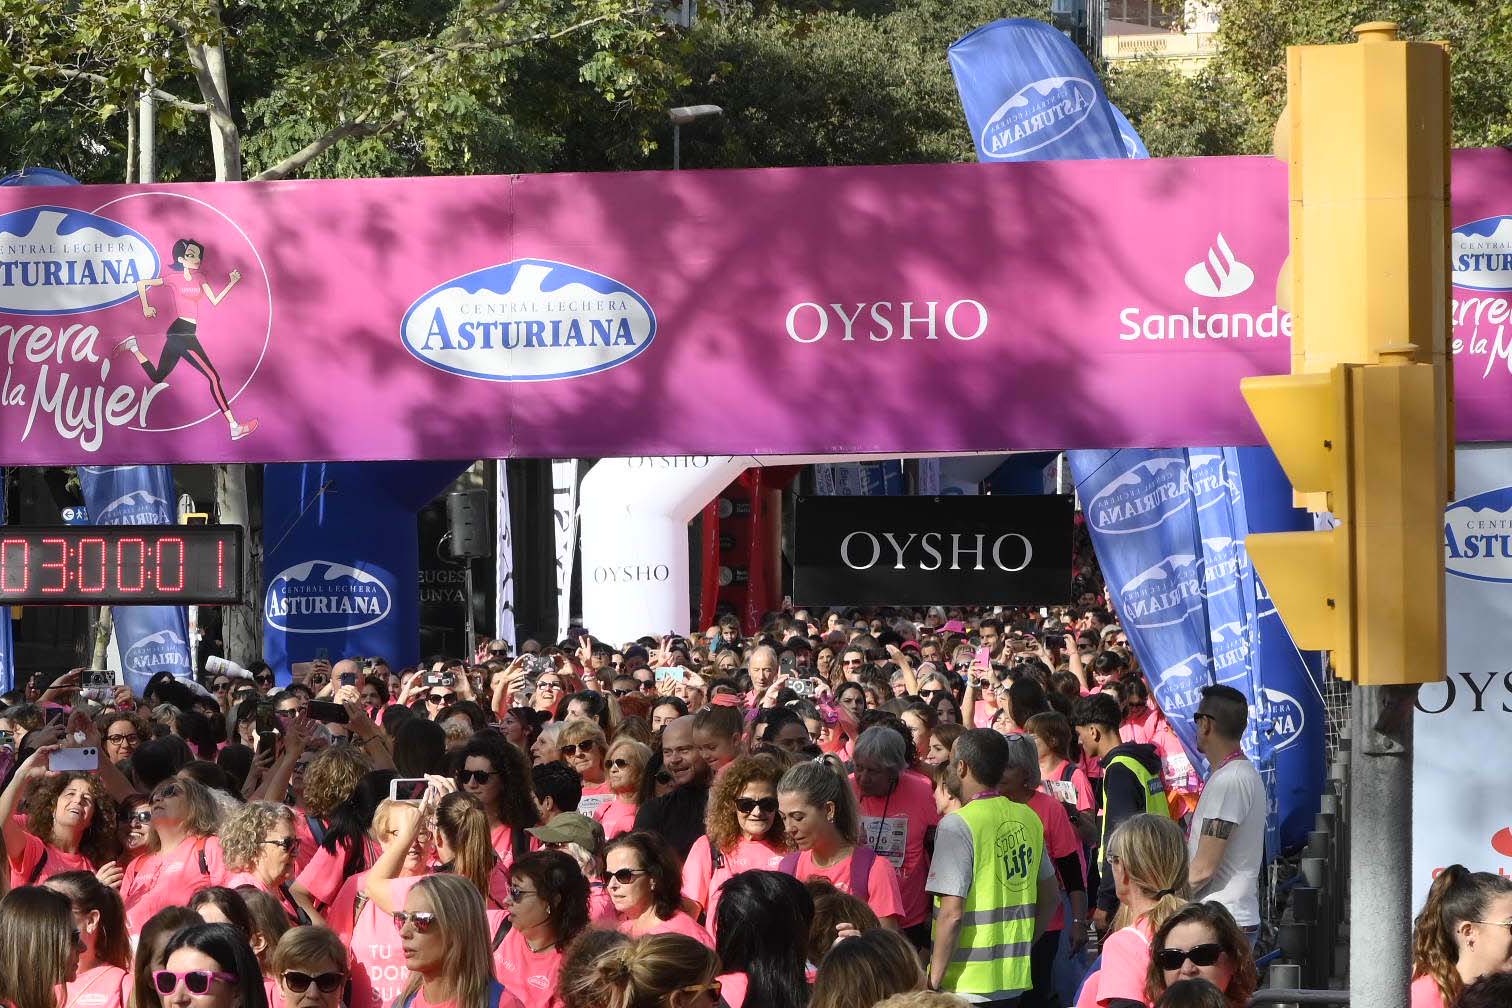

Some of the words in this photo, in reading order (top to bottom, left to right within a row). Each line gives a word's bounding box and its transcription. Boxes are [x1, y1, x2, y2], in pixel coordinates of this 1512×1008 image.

[63, 242, 135, 253] LECHERA
[1452, 253, 1512, 272] STUR
[460, 301, 539, 314] CENTRAL
[546, 300, 627, 312] LECHERA
[421, 307, 636, 350] ASTURIANA
[786, 299, 988, 343] OYSHO
[1119, 305, 1294, 341] Santande
[1470, 327, 1487, 355] la
[1, 367, 26, 406] la
[21, 357, 170, 451] Mujer
[1467, 520, 1512, 529] CENT
[840, 531, 1033, 572] OYSHO
[1445, 523, 1512, 559] ASTU
[1, 538, 223, 592] 03:00:01
[593, 564, 670, 584] OYSHO
[328, 585, 377, 593] LECHERA
[418, 590, 466, 602] UNYA
[268, 590, 382, 617] ASTURIANA
[995, 825, 1027, 858] Sport
[1003, 843, 1033, 881] Life
[368, 944, 391, 960] TU
[370, 965, 408, 981] DOR
